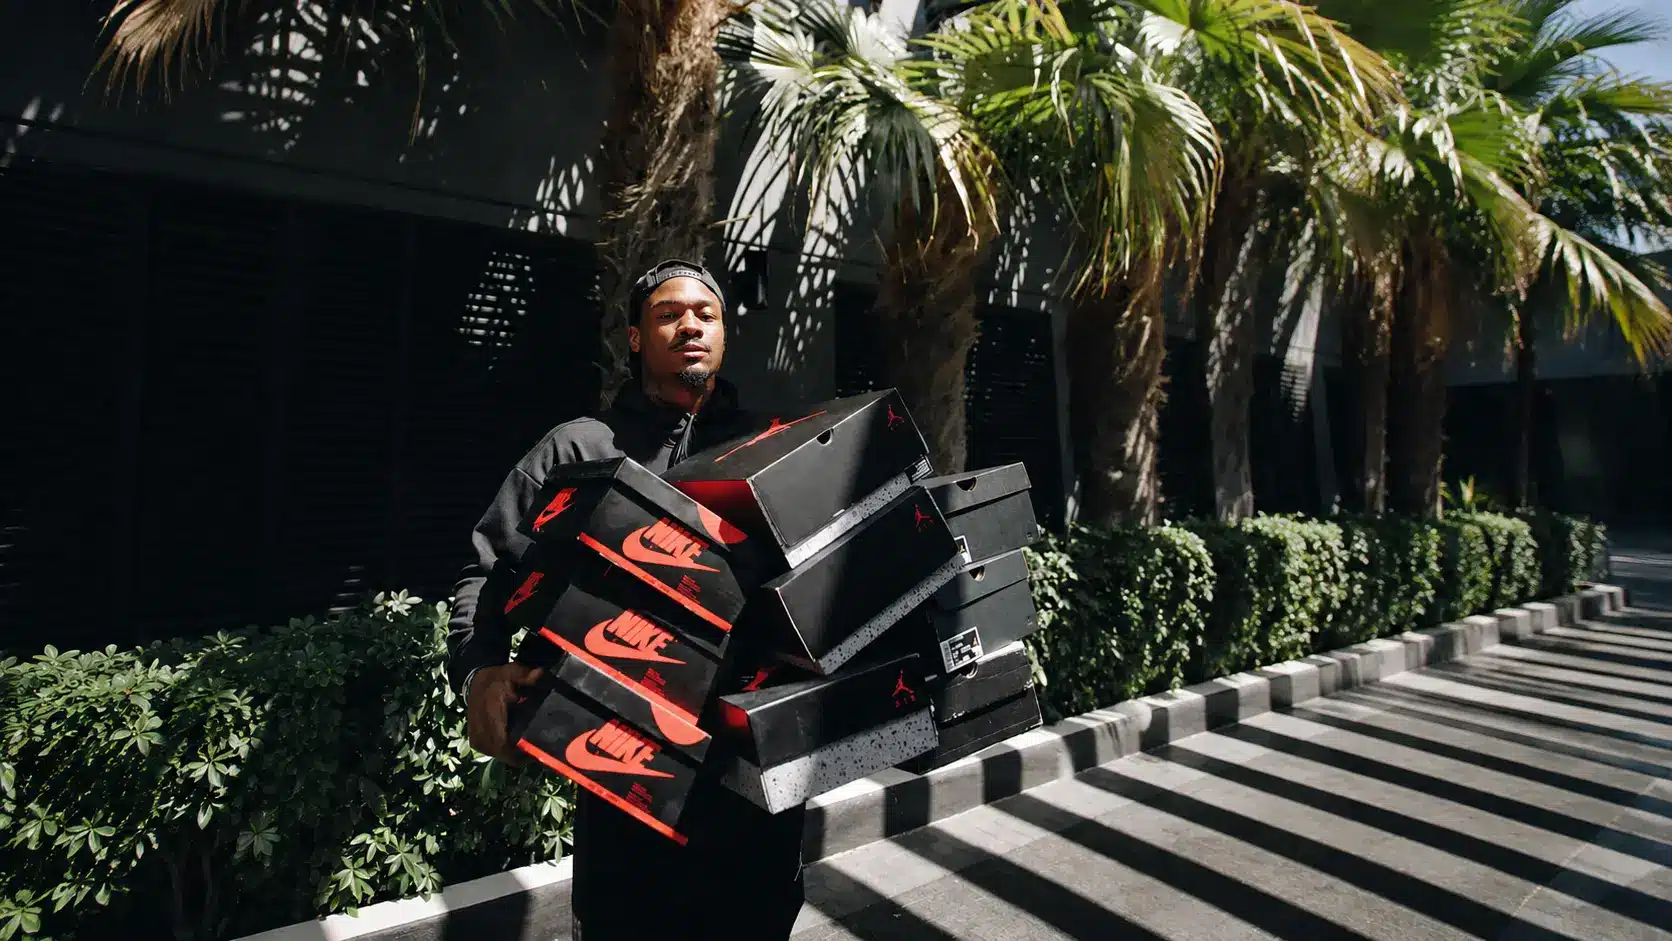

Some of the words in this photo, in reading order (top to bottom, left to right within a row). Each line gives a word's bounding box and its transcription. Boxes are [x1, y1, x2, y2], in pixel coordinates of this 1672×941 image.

[643, 516, 710, 562] NIKE
[605, 609, 676, 654] NIKE
[588, 718, 662, 766] NIKE
